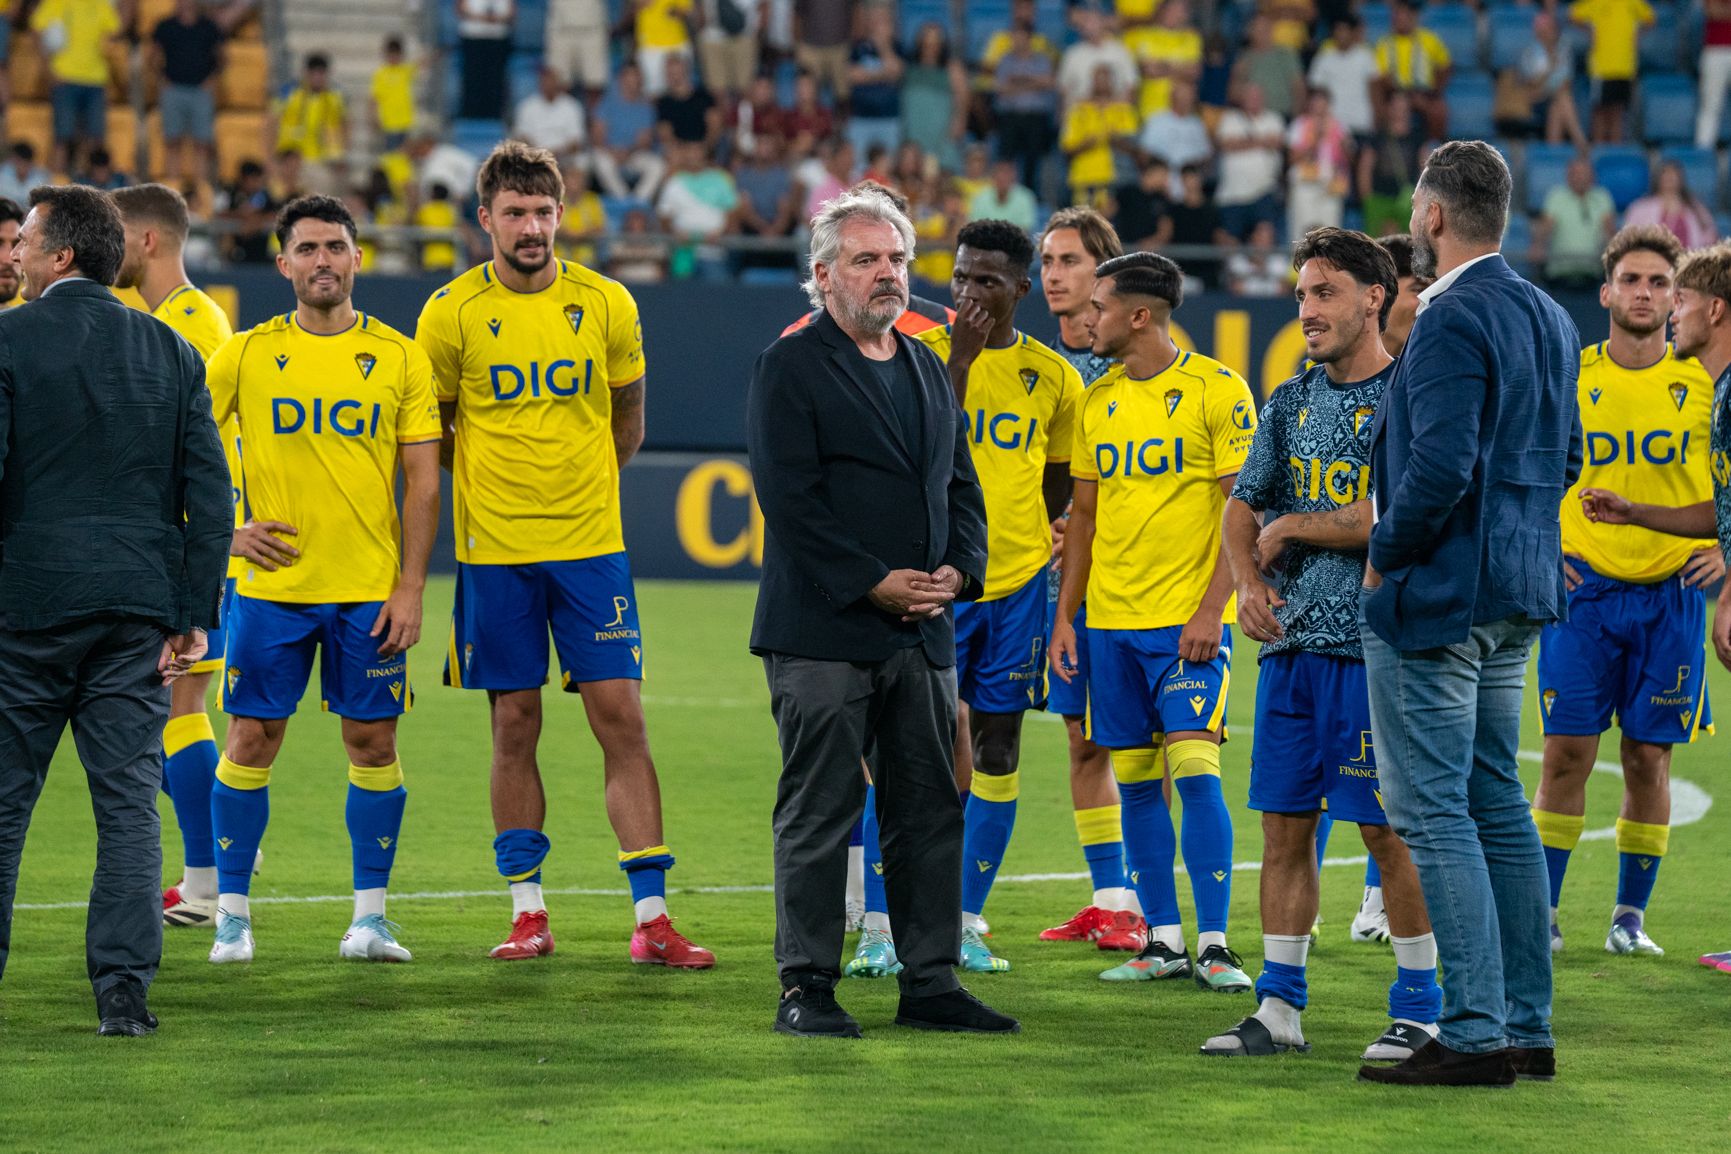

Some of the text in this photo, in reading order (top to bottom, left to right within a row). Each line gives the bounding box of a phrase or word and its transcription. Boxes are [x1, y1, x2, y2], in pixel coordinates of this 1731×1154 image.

[490, 359, 593, 401] DIGI
[271, 397, 381, 439] DIGI
[963, 409, 1037, 453] IGI
[1095, 436, 1183, 479] DIGI
[1587, 430, 1690, 466] DIGI
[1289, 456, 1371, 505] DIGI
[1164, 680, 1208, 695] FINANCIAL
[1383, 1034, 1408, 1043] macron
